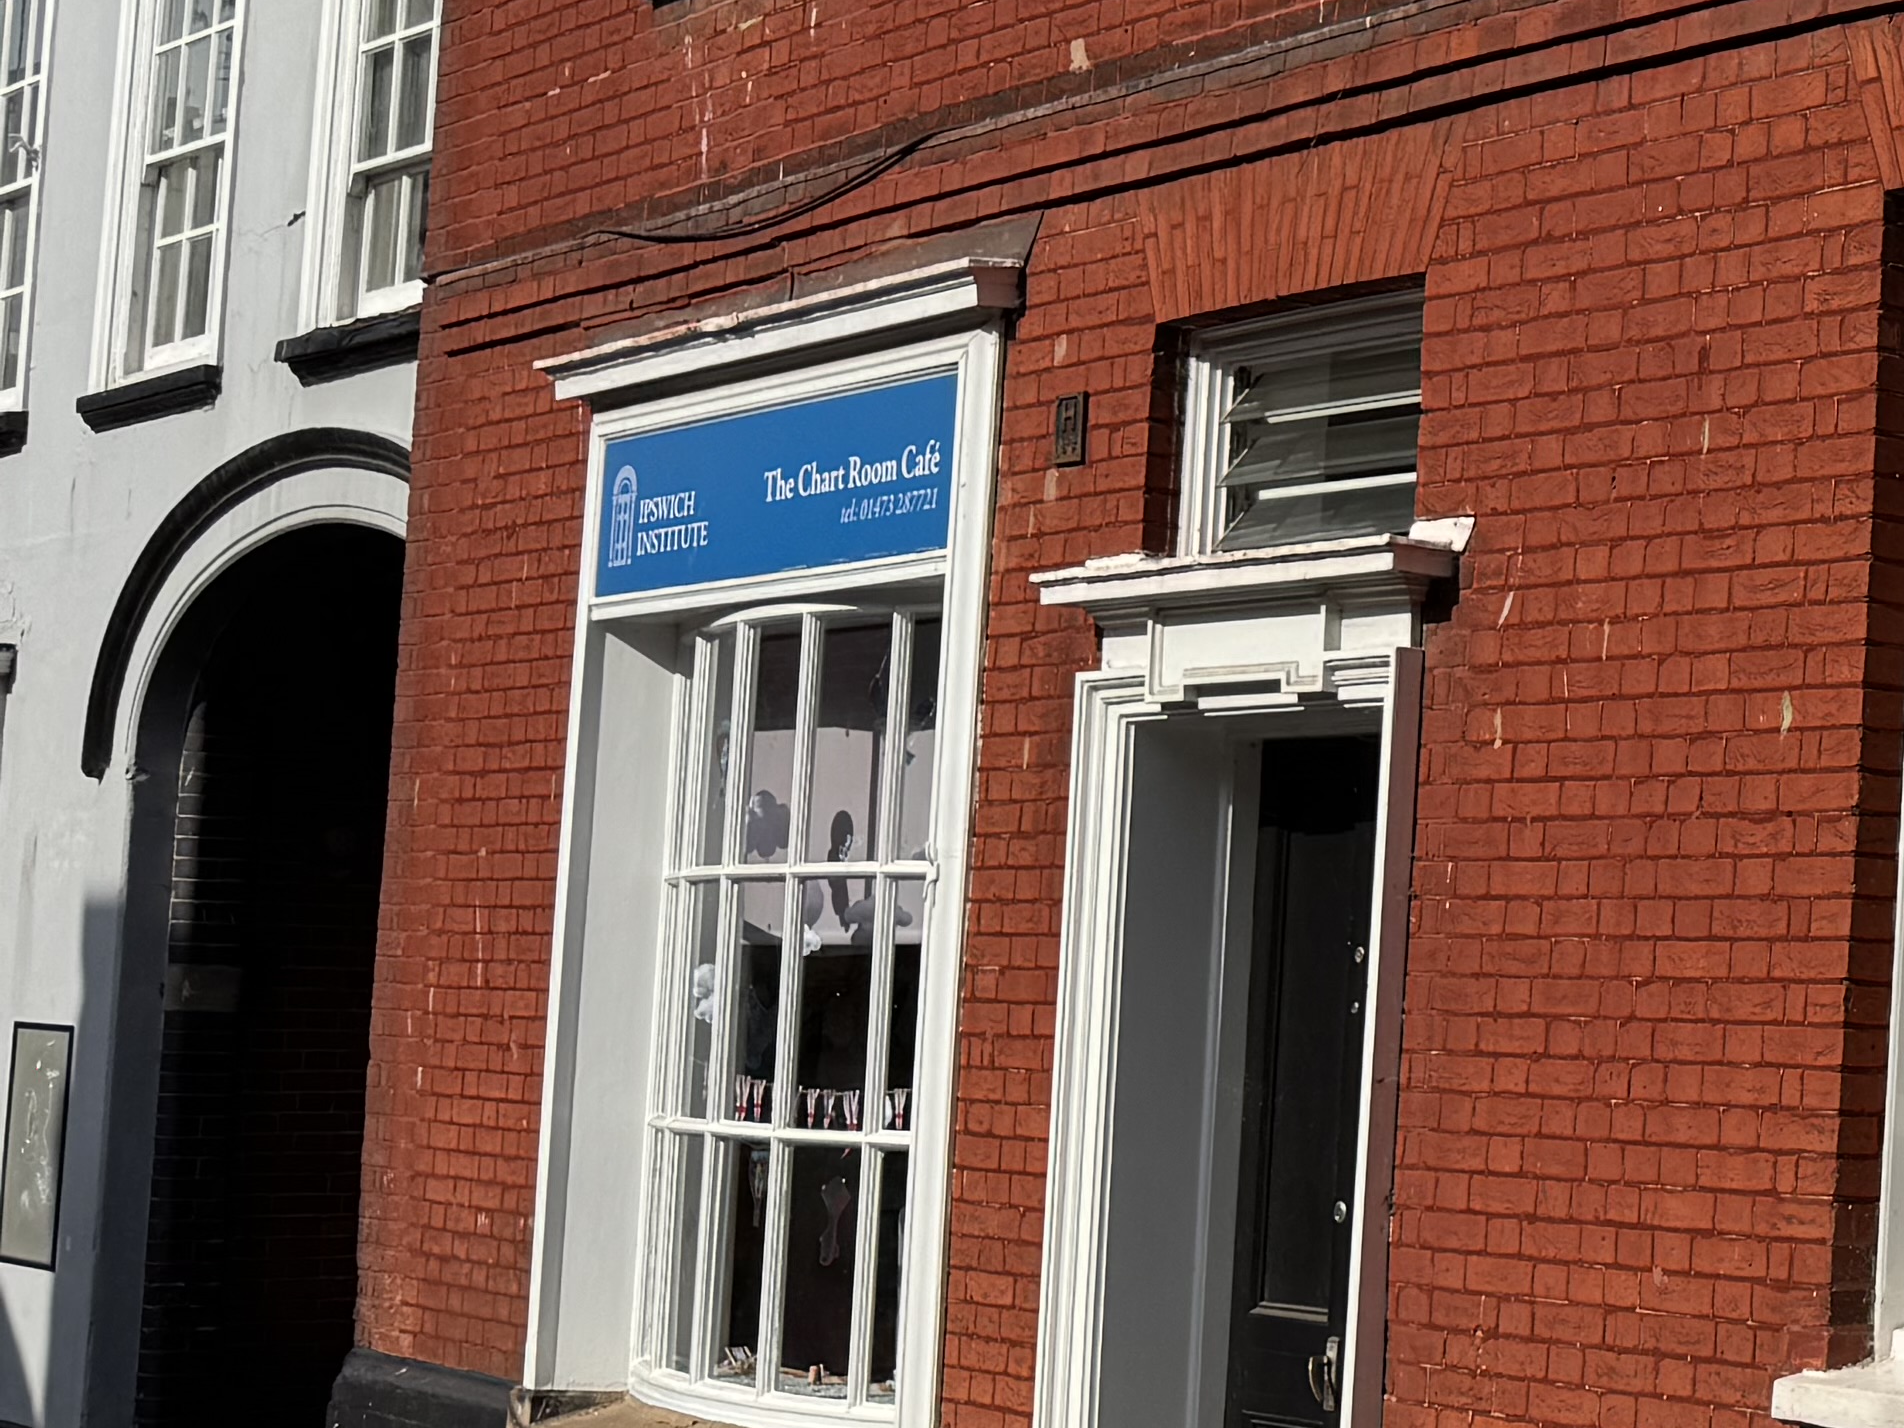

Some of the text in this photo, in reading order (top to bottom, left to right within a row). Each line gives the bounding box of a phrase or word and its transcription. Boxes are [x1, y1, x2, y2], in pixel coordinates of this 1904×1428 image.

[764, 439, 941, 502] The Chart Room Café
[638, 491, 696, 524] IPSWICH
[840, 487, 939, 524] tel: 01473 287721
[636, 521, 709, 556] INSTITUTE
